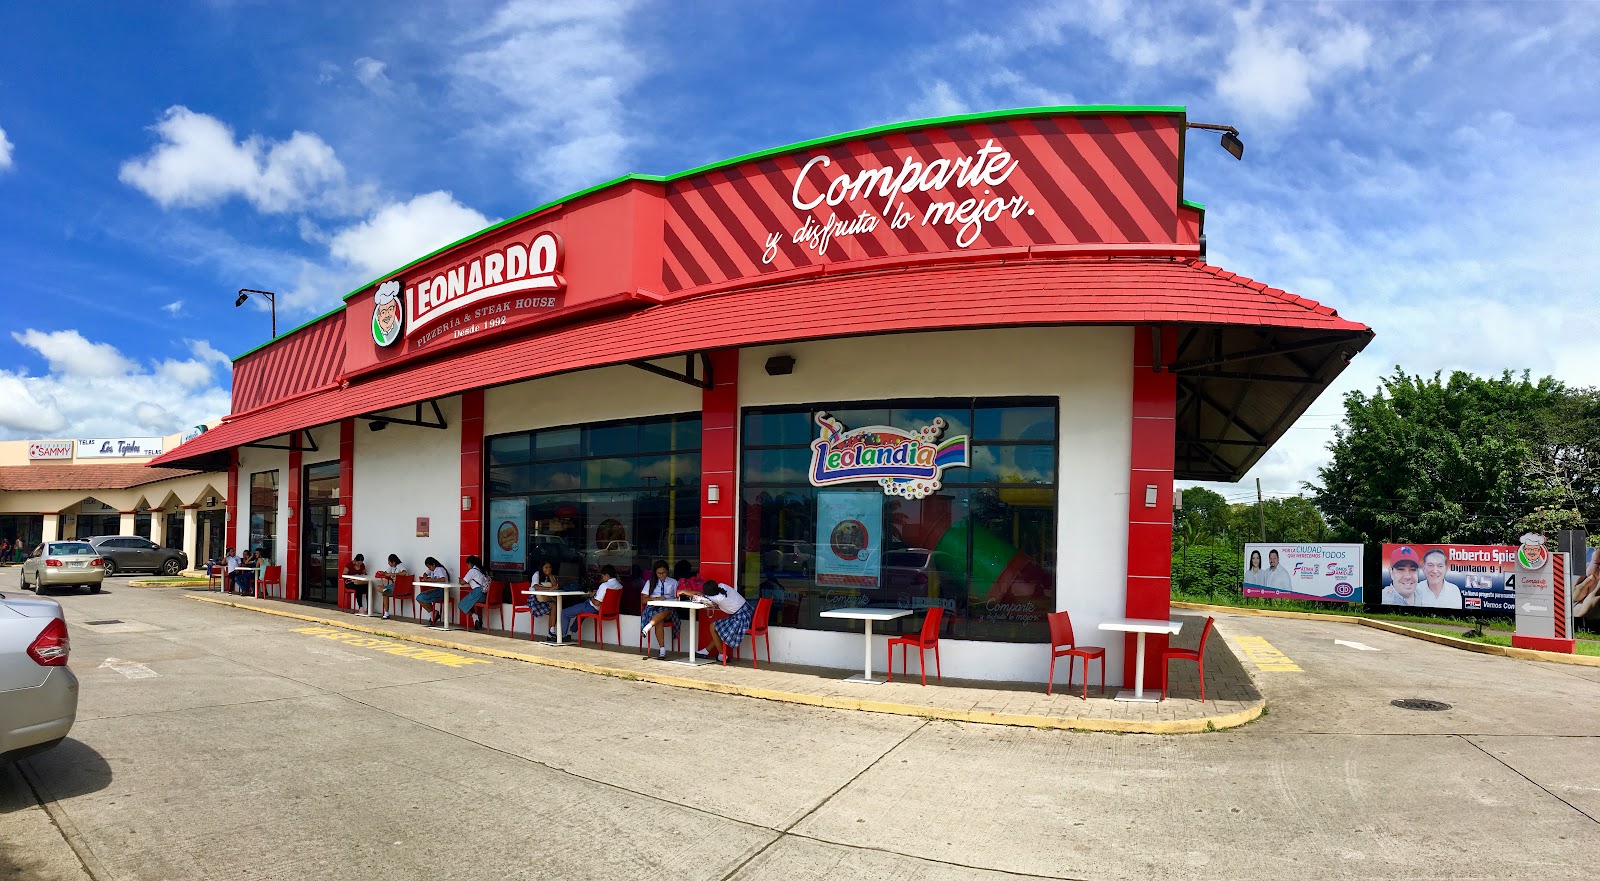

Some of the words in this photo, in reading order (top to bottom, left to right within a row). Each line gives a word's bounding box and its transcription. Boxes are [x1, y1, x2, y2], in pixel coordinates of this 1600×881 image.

[792, 139, 1020, 216] Comparte
[761, 230, 783, 264] y
[792, 210, 880, 255] disfruta
[890, 201, 915, 230] lo
[921, 189, 1035, 248] mejor.
[405, 233, 558, 338] LEONARDO
[417, 317, 461, 348] PIZZERÍA
[464, 313, 472, 322] &
[474, 301, 511, 319] STEAK
[515, 297, 556, 309] HOUSE
[453, 325, 480, 339] Desde
[483, 316, 507, 330] 1992
[38, 447, 70, 456] SAMMY
[814, 438, 938, 481] Leolandia
[1322, 551, 1346, 559] TODOS
[1449, 548, 1490, 561] Roberto
[1450, 564, 1487, 573] Diputado
[1490, 565, 1502, 573] 9-1
[1465, 575, 1492, 589] RS
[826, 590, 870, 605] Comparte
[986, 598, 1036, 614] Comparte
